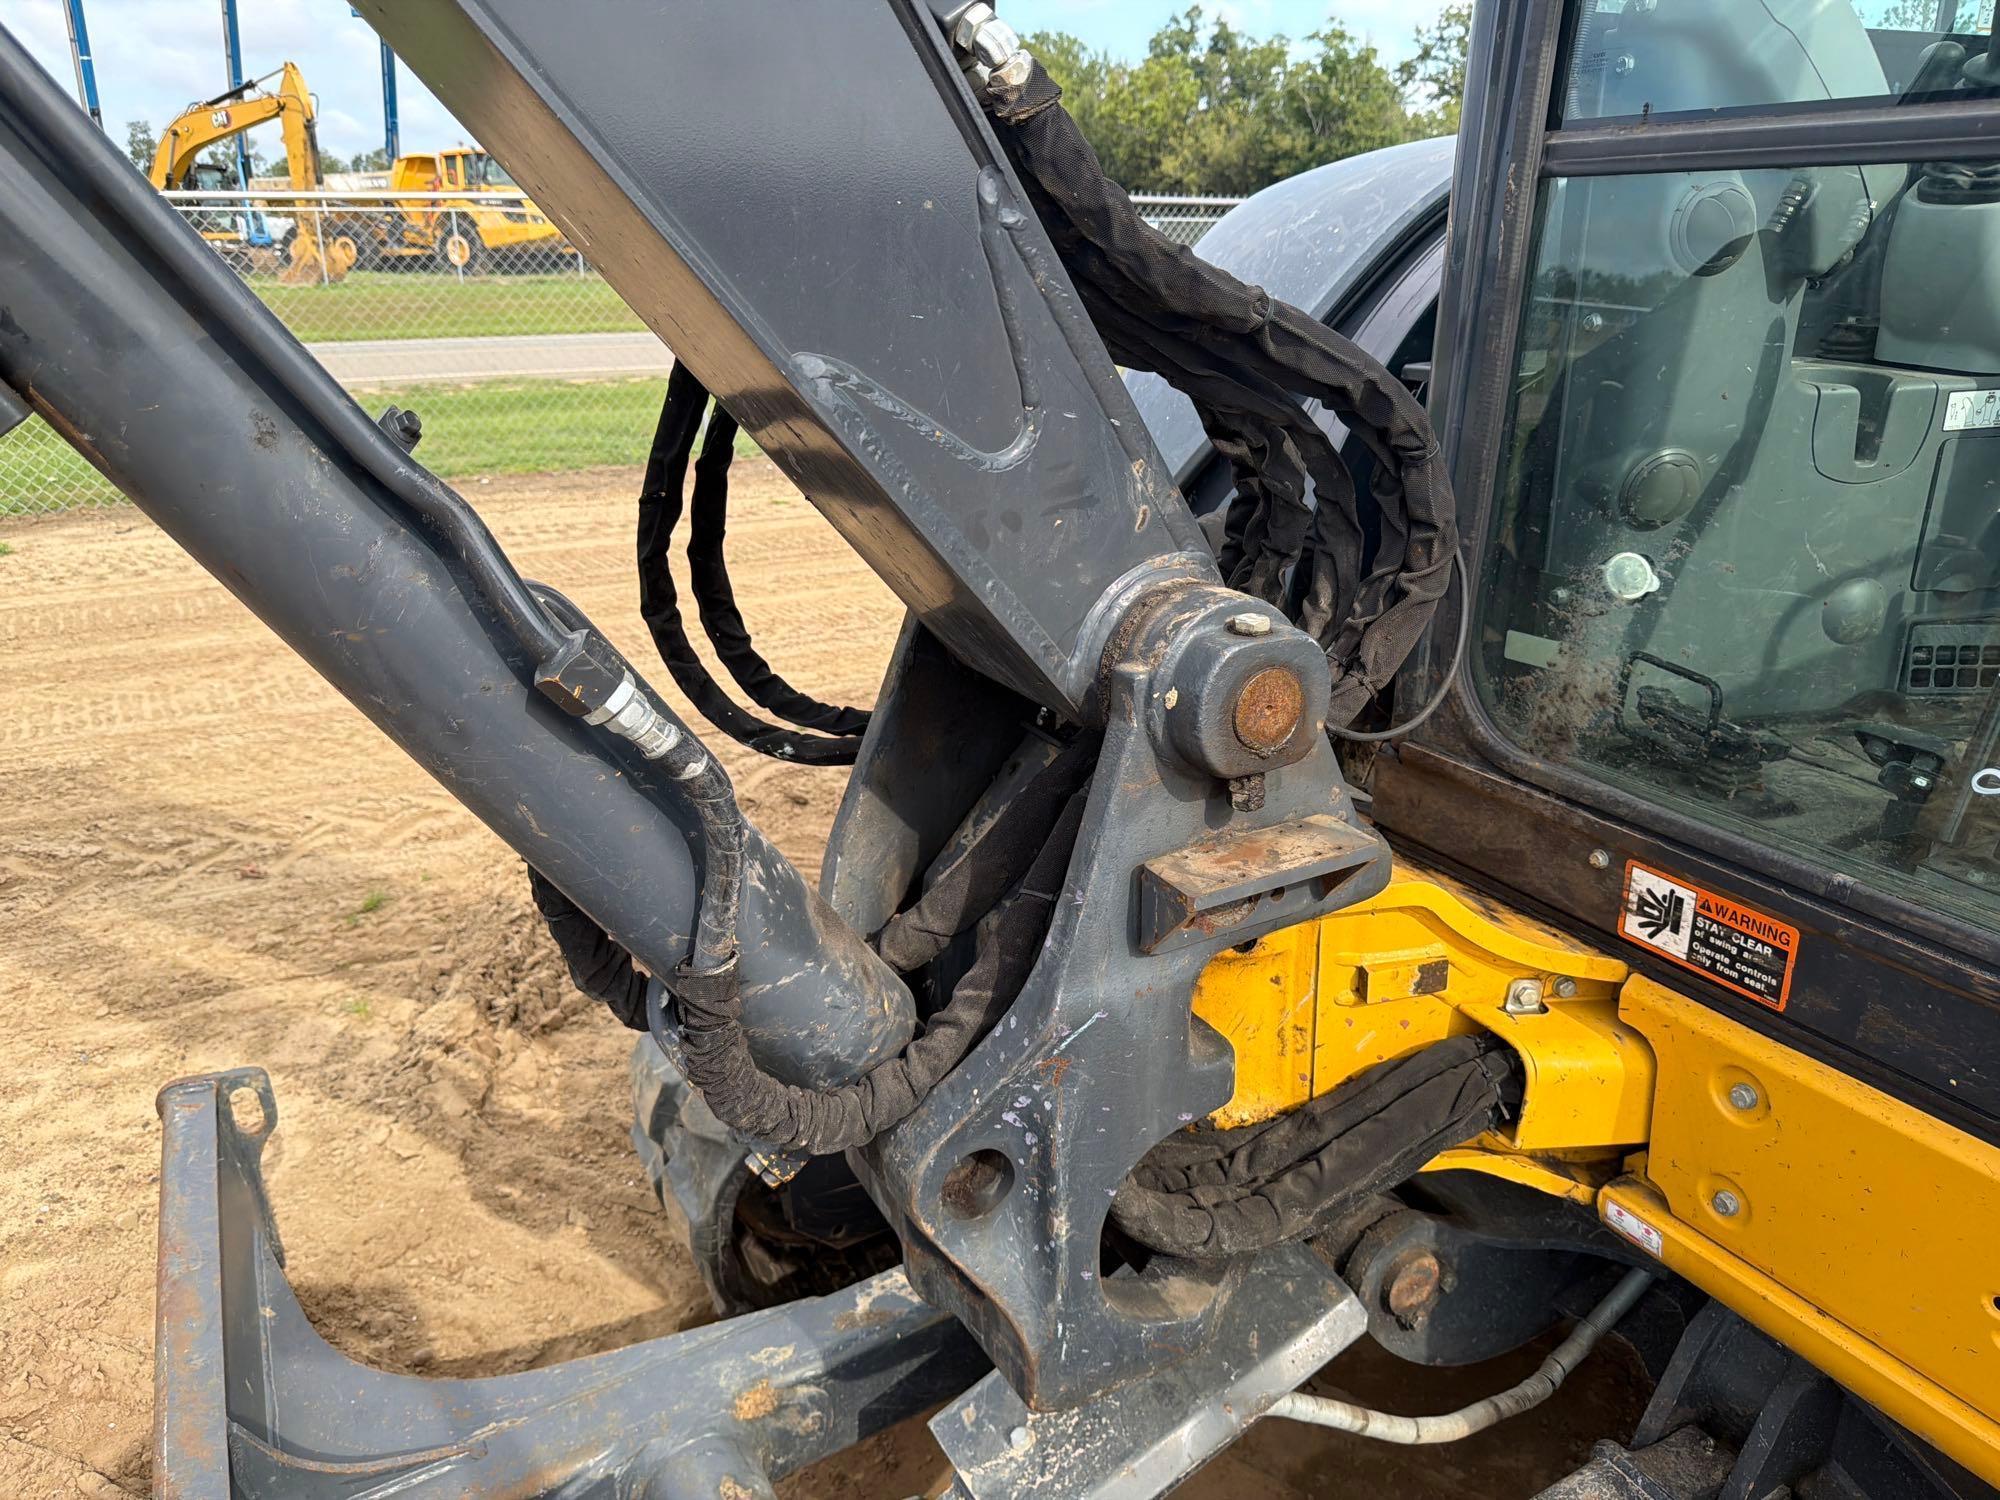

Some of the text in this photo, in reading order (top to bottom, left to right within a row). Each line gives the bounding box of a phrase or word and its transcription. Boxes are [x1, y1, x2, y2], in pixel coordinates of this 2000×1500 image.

[211, 110, 228, 128] CAT
[1694, 930, 1705, 939] of
[1709, 936, 1738, 955] swing
[1696, 916, 1773, 957] STAY CLEAR
[1714, 902, 1791, 947] WARNING
[1692, 941, 1777, 986] Operate controls
[1716, 962, 1739, 979] from
[1744, 976, 1768, 993] seat.
